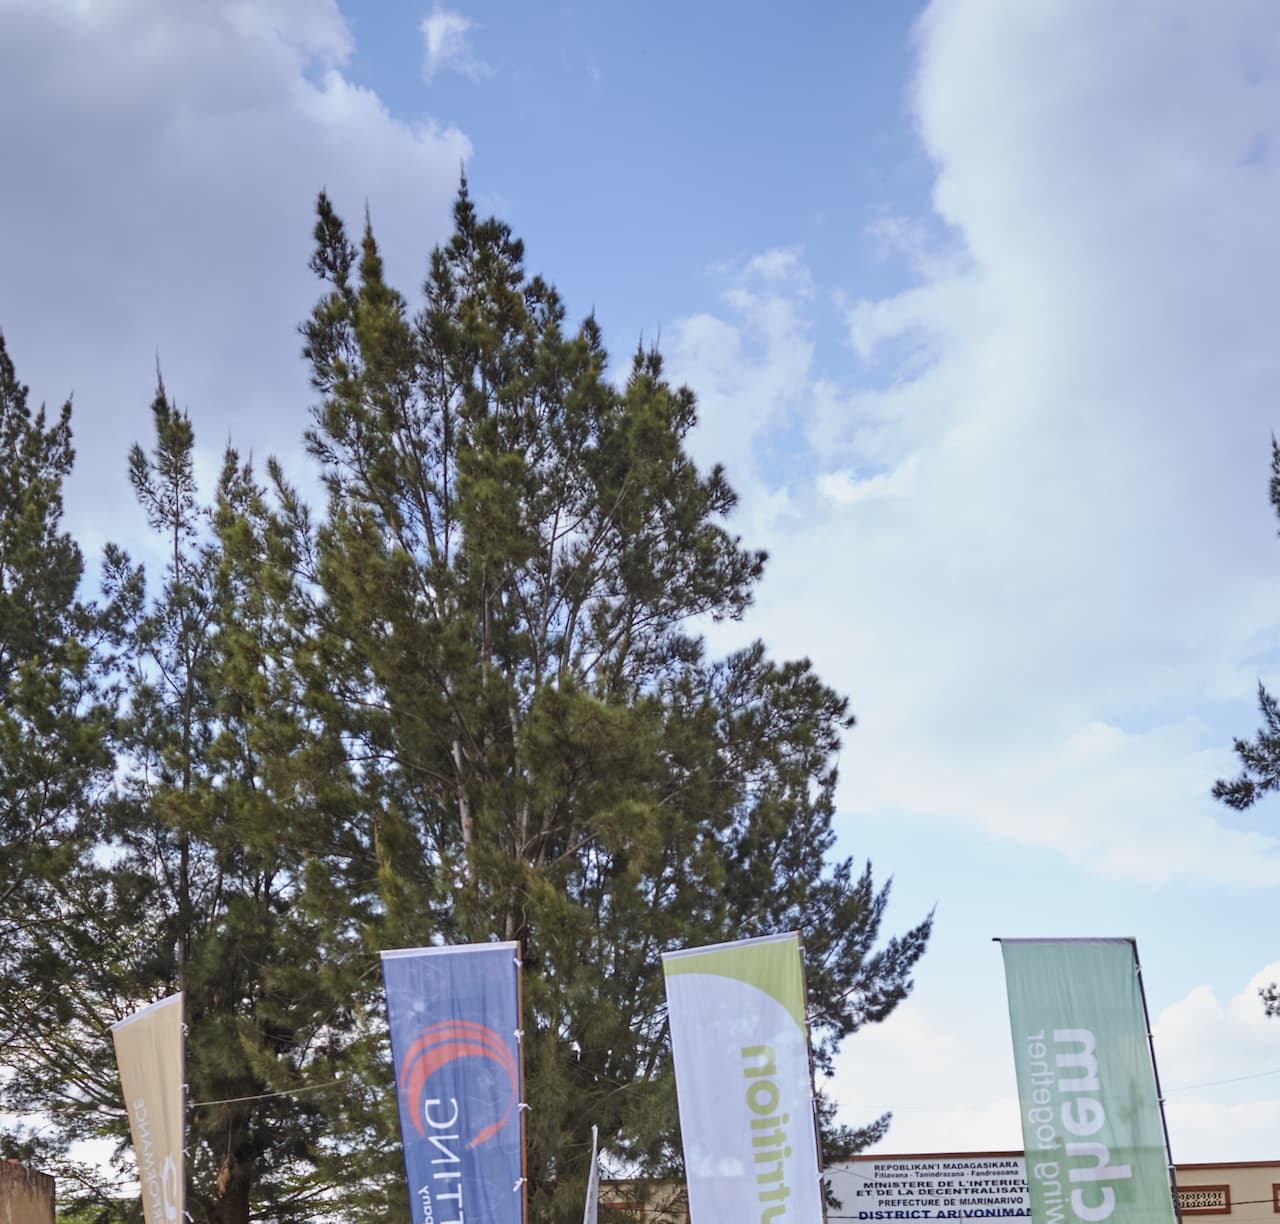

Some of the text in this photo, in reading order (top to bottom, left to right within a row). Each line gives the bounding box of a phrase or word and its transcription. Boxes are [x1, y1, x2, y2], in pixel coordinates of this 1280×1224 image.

[943, 1161, 1019, 1170] MADAGASIKARA
[874, 1171, 909, 1179] Fitiavana
[915, 1170, 965, 1178] Tanindrazana
[864, 1181, 931, 1189] MINISTERE
[934, 1180, 952, 1188] DE
[876, 1189, 894, 1197] DE
[878, 1196, 1024, 1207] PREFECTURE DE MIARINARIVO
[858, 1210, 931, 1220] DISTRICT
